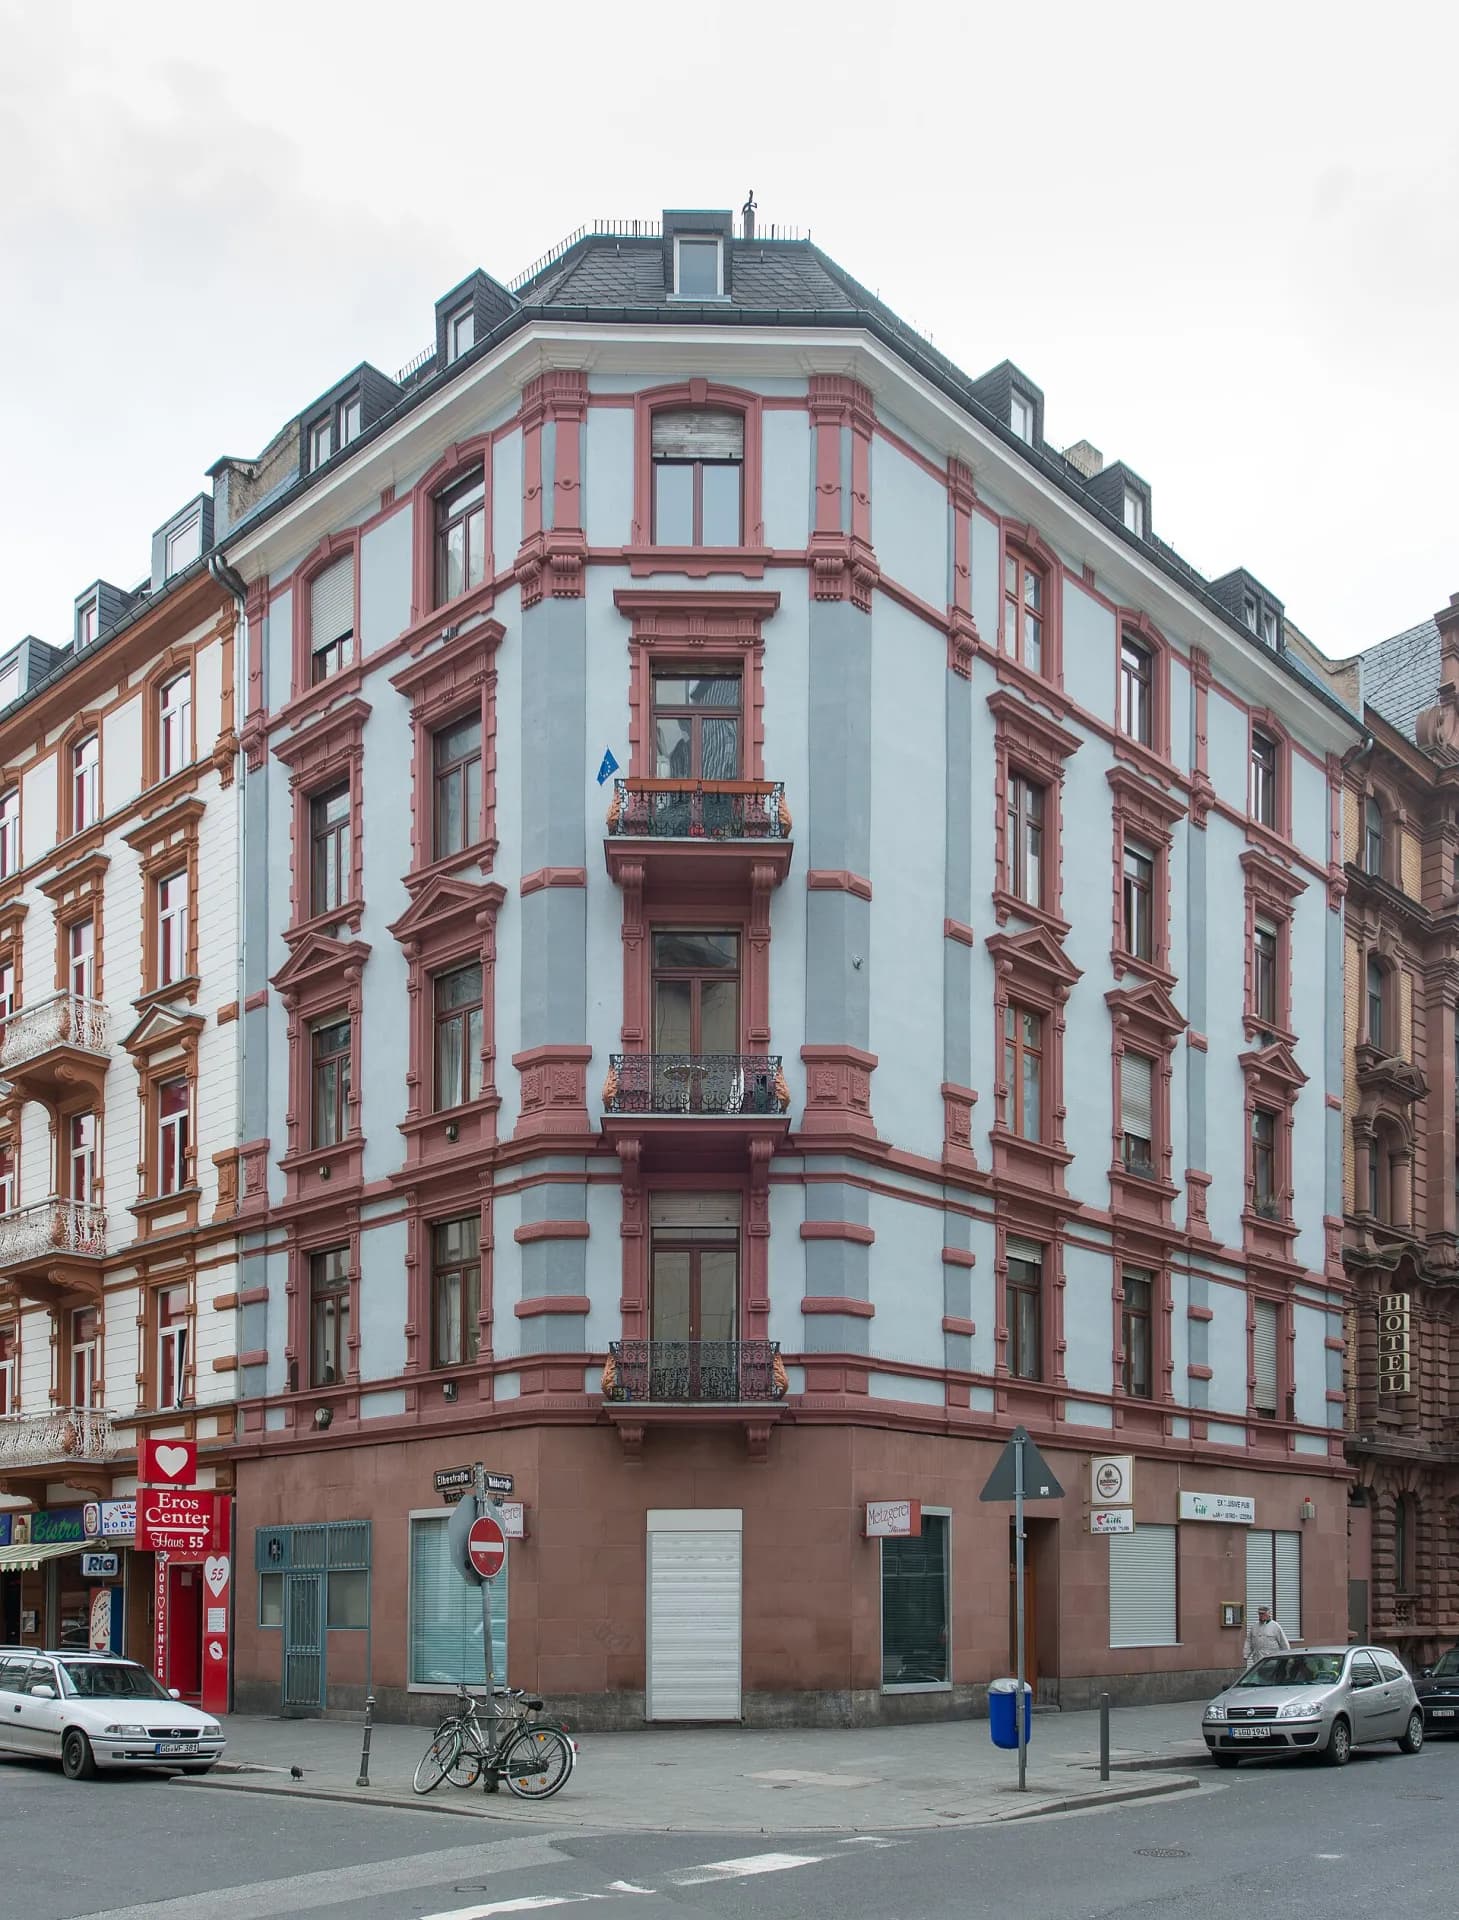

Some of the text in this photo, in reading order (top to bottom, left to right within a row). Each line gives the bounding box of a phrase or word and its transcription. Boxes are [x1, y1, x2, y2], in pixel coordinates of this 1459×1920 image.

[1384, 1295, 1403, 1392] HOTEL
[437, 1472, 469, 1486] Elbestraße
[157, 1492, 199, 1510] Eros
[104, 1511, 114, 1521] La
[113, 1503, 132, 1512] Vida
[145, 1507, 210, 1525] Center
[868, 1504, 909, 1527] Metzgerei
[33, 1511, 81, 1540] Bistro
[151, 1532, 204, 1548] Haus 55
[88, 1555, 115, 1572] Ria
[210, 1568, 224, 1581] 55
[157, 1561, 166, 1678] ROS CENTER
